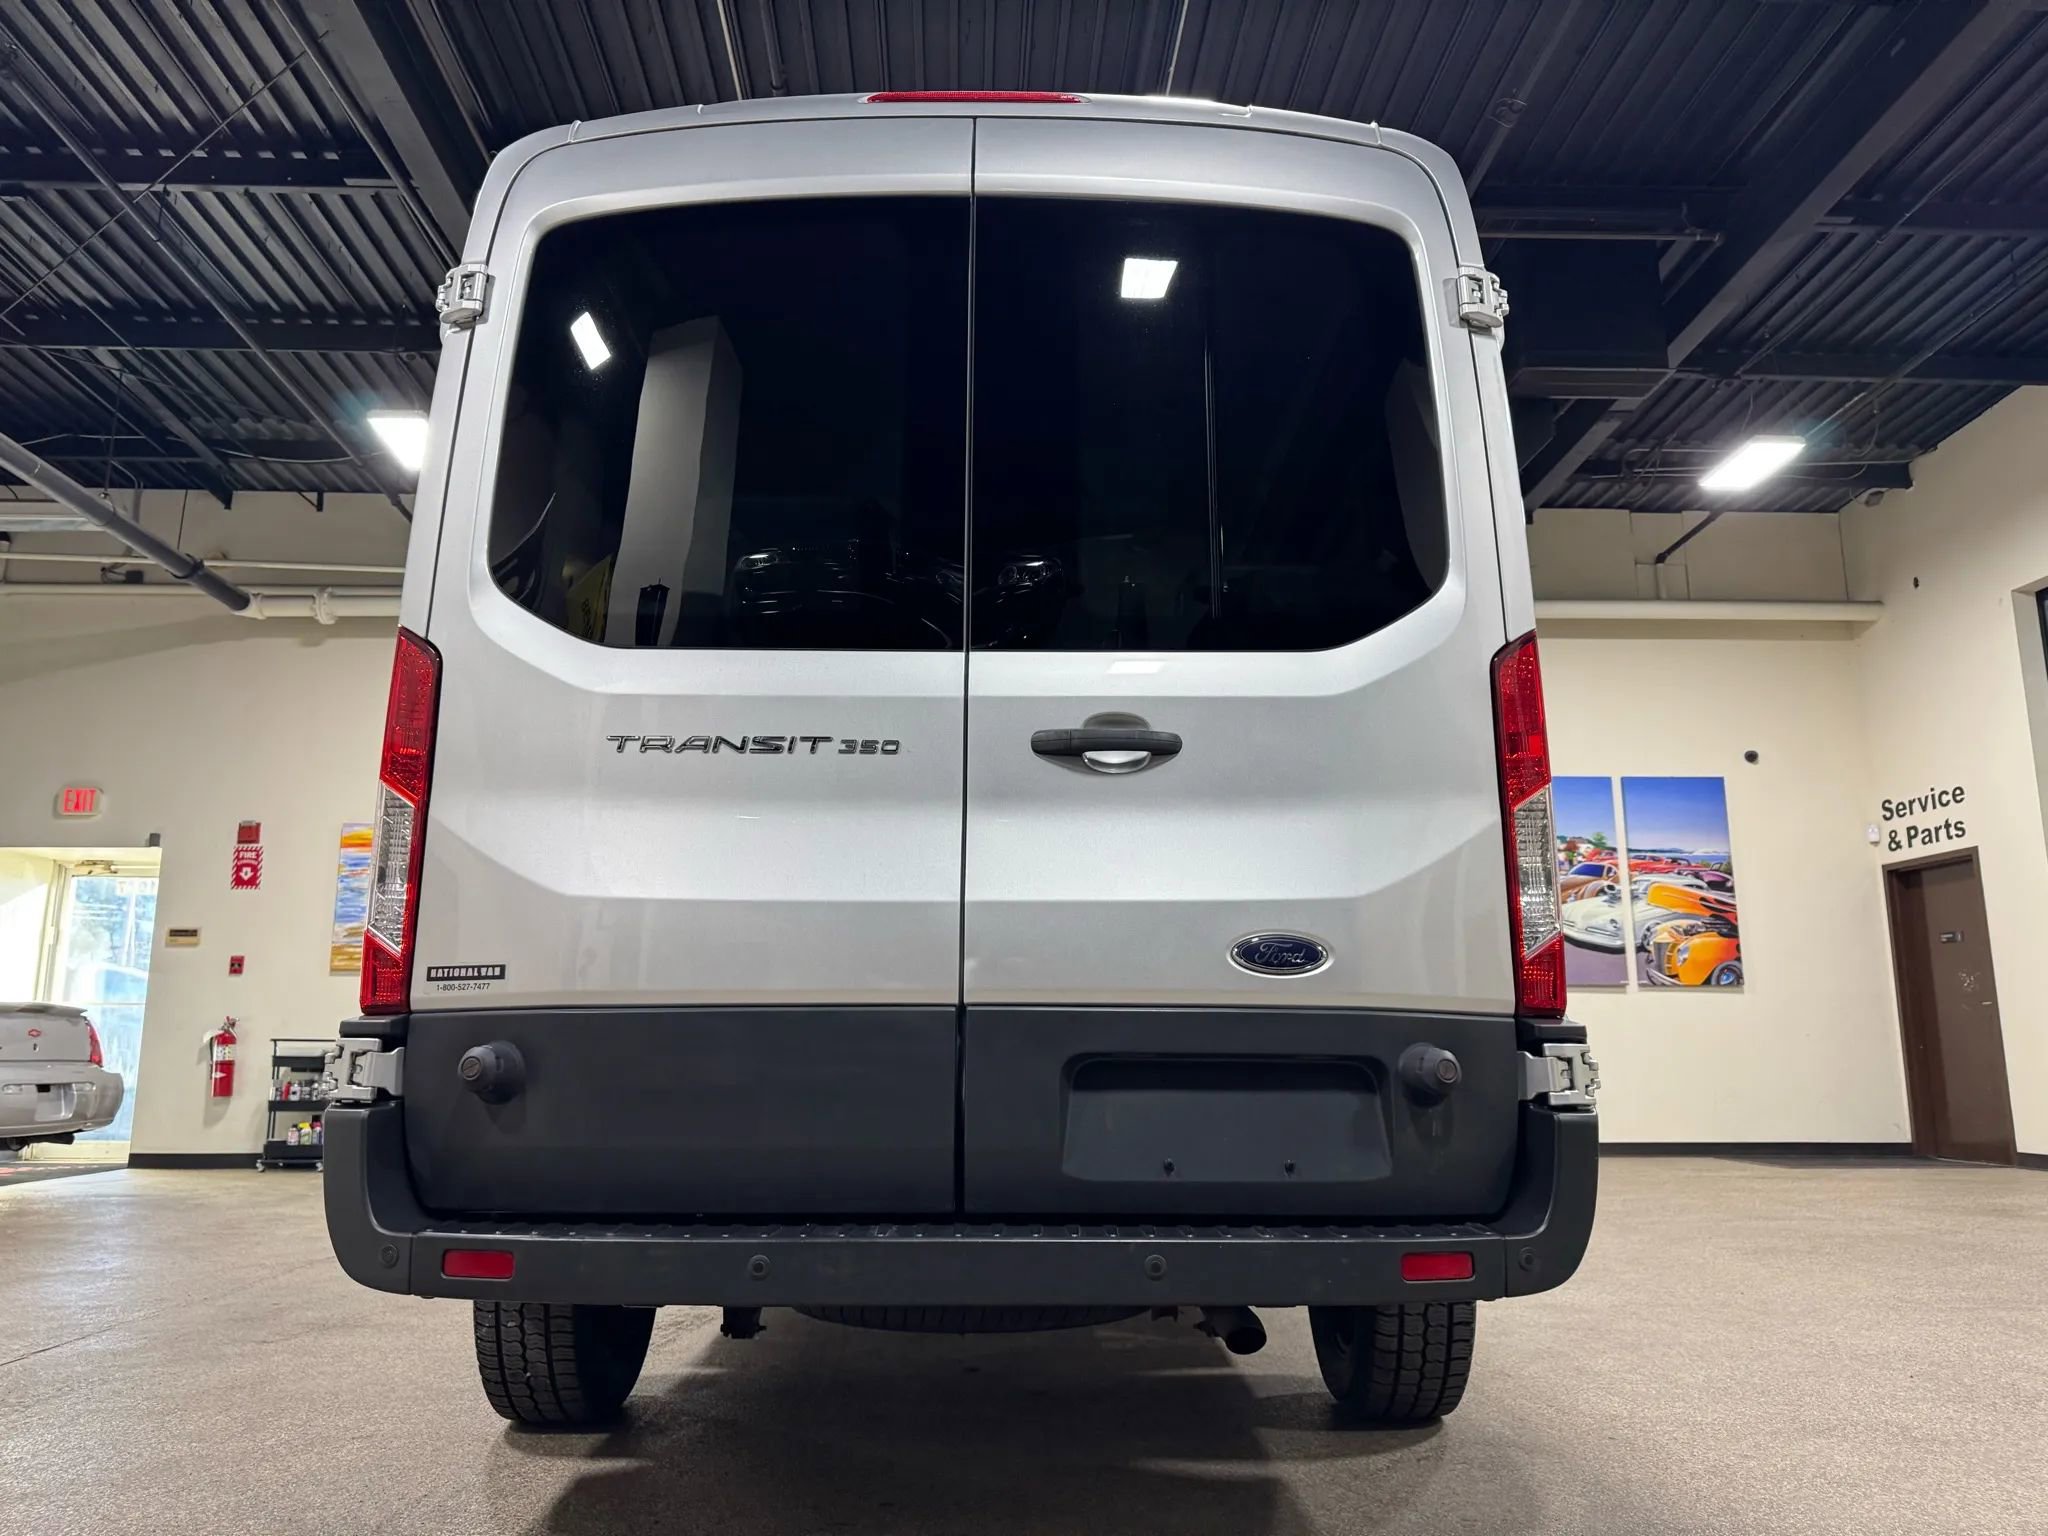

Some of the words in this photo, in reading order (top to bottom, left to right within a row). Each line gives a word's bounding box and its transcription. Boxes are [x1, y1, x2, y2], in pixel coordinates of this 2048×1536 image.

[606, 735, 833, 754] TRANSIT
[837, 739, 901, 755] 350
[63, 787, 97, 813] EXIT
[1881, 785, 1966, 822] Service
[1887, 829, 1903, 852] &
[1905, 818, 1967, 849] Parts
[238, 851, 258, 859] FIRE
[1254, 942, 1306, 964] Ford
[430, 968, 478, 978] NATIONAL
[480, 966, 501, 976] VAN
[436, 983, 490, 991] 1-800-527-7477
